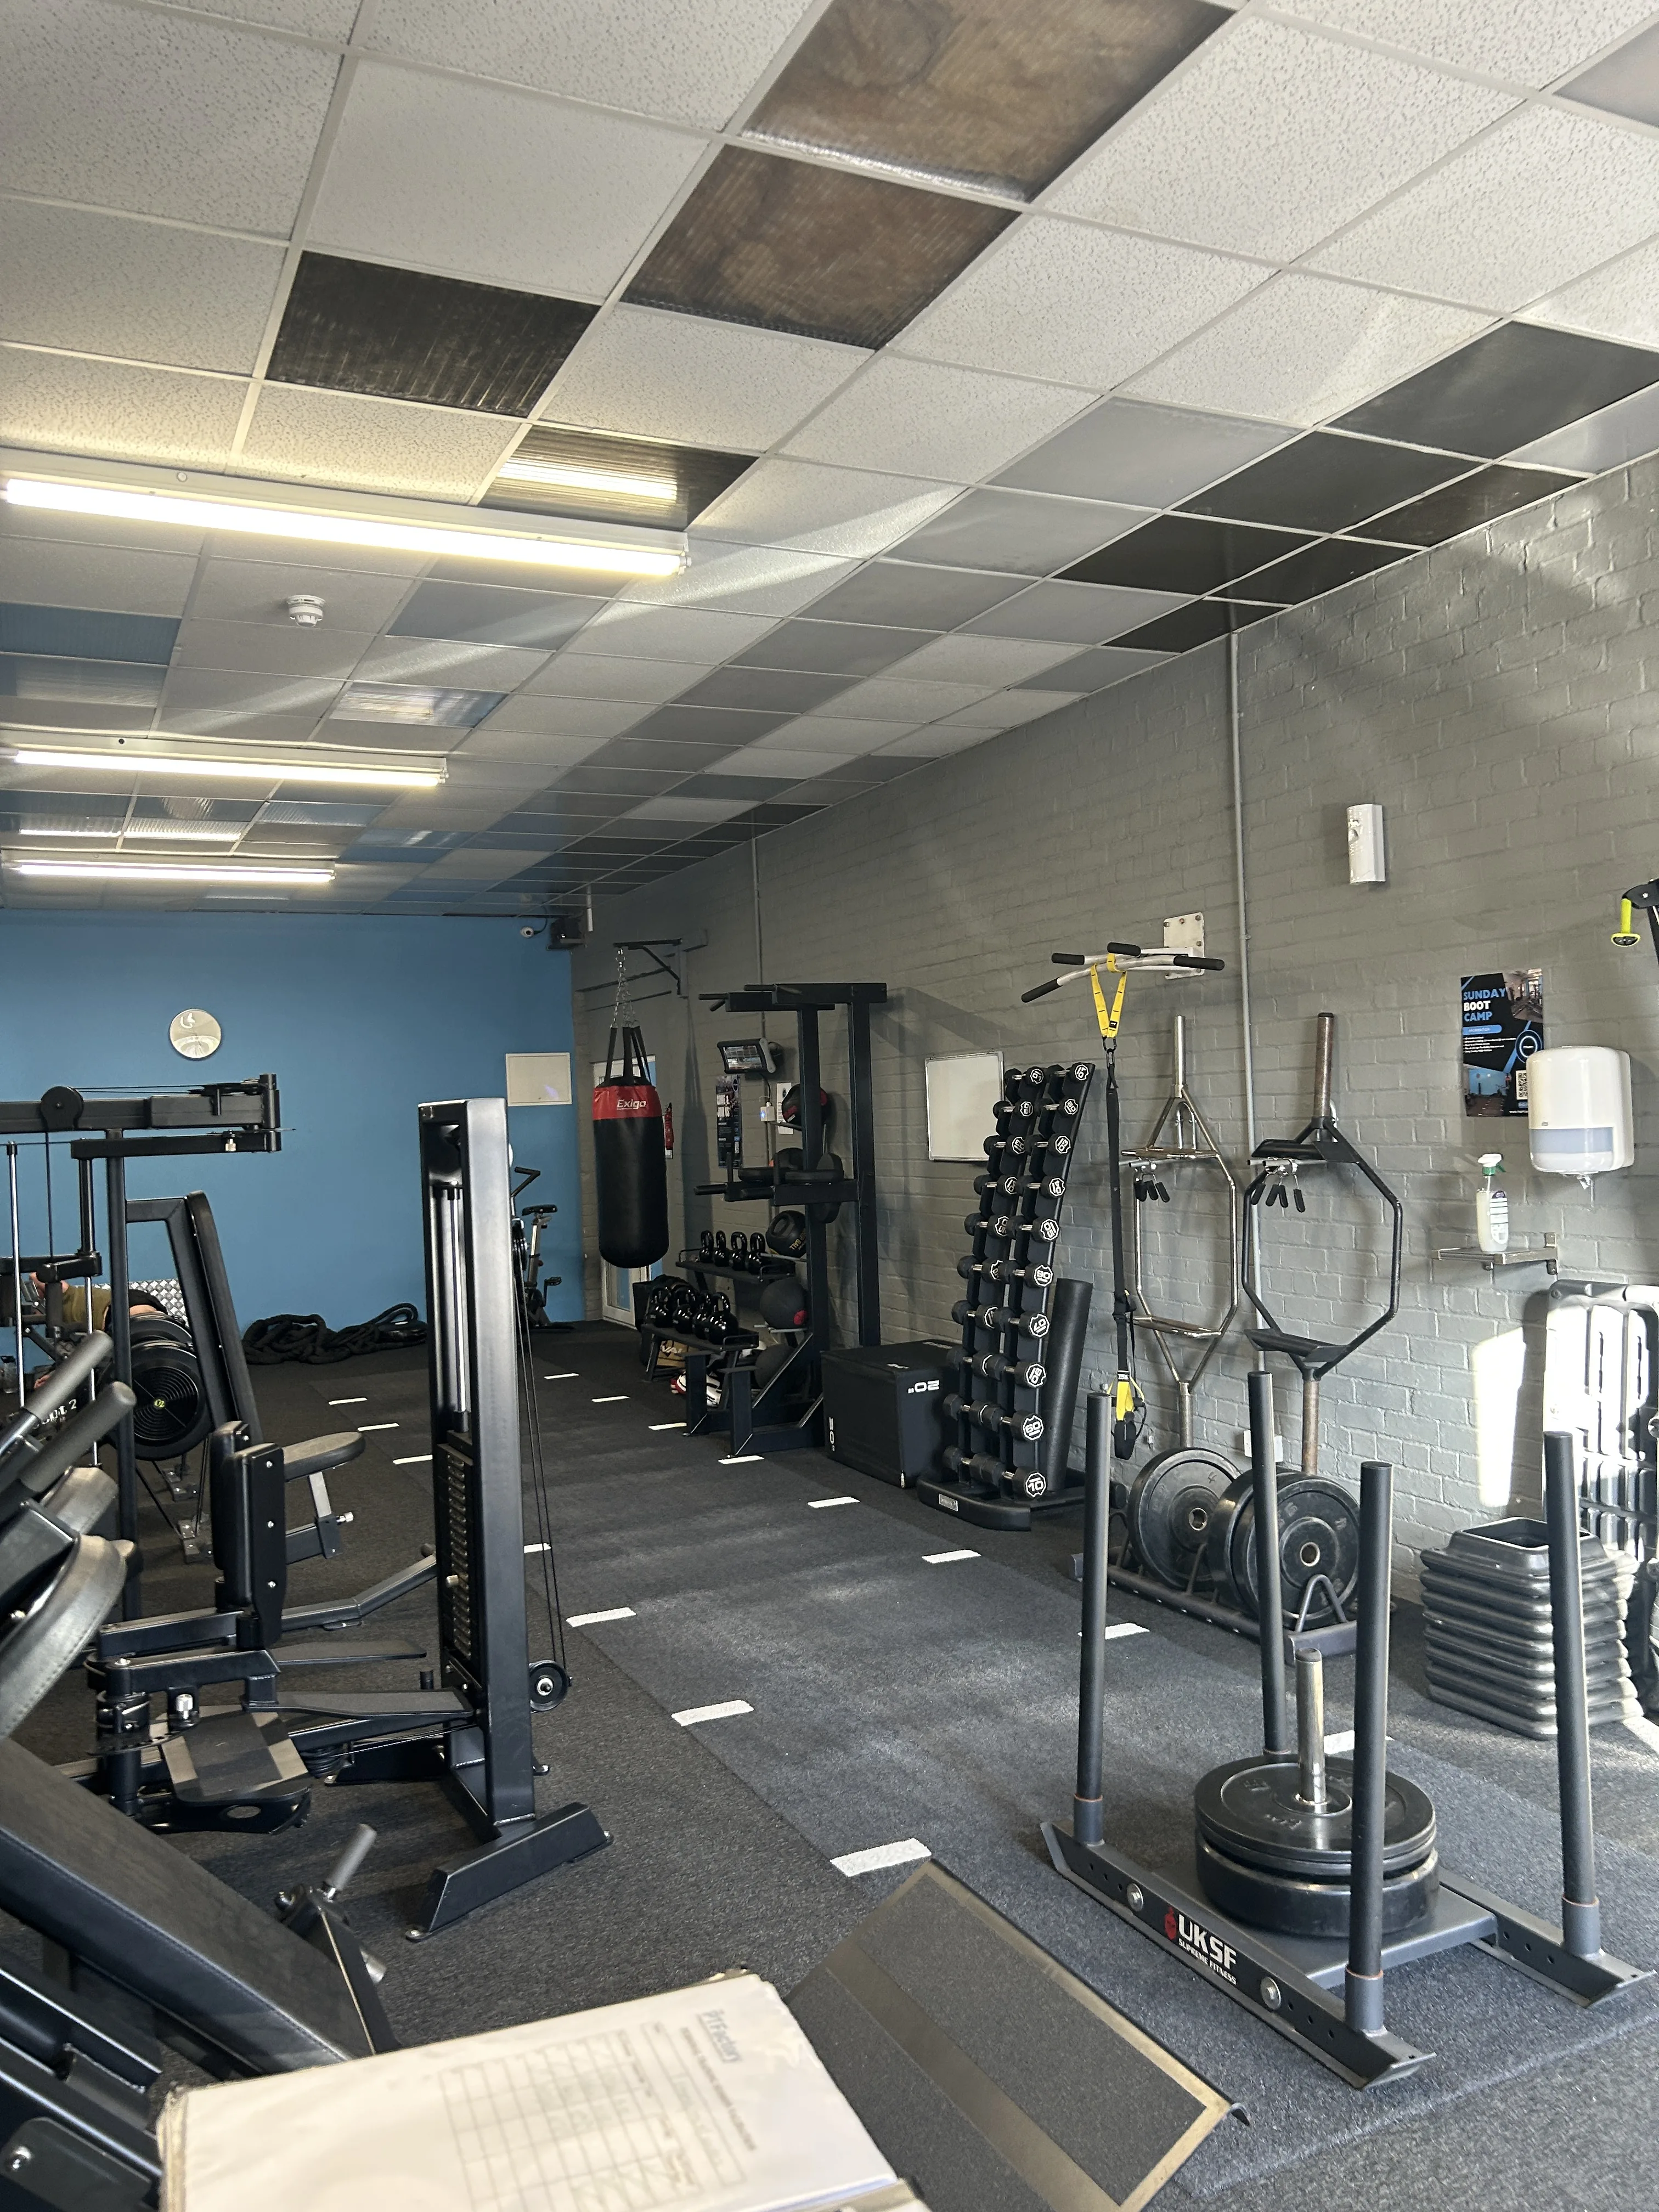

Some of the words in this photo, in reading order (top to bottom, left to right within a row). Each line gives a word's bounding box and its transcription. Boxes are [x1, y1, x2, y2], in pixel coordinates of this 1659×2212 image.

[1463, 988, 1506, 1001] SUNDAY
[1463, 1000, 1491, 1011] BOOT
[1464, 1011, 1493, 1022] CAMP
[617, 1098, 646, 1110] Exigo
[1179, 1913, 1237, 1970] UKSF
[1179, 1938, 1209, 1965] SUPREME
[1210, 1961, 1237, 1985] FITNESS
